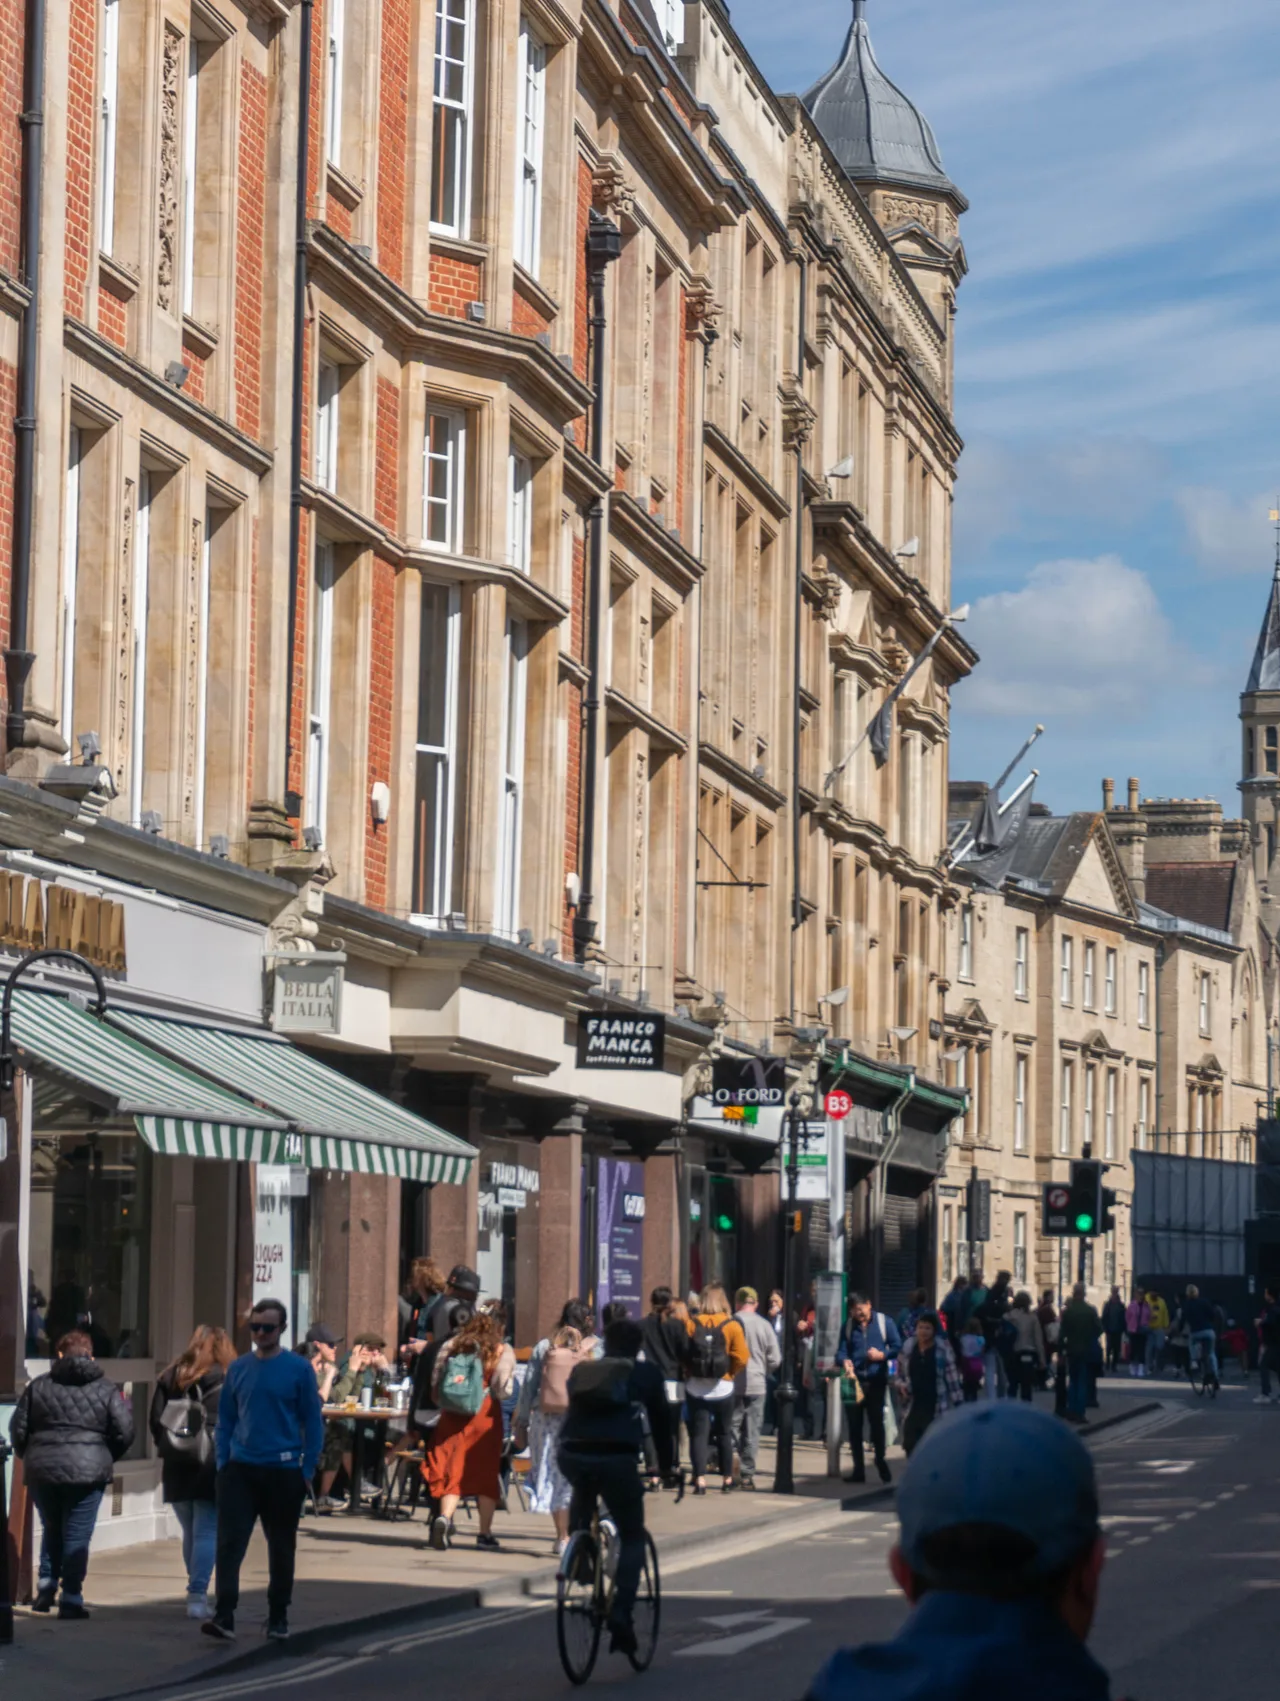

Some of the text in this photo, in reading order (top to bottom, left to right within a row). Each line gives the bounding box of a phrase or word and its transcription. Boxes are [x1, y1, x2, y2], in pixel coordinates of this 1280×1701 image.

[283, 980, 333, 998] BELLA
[281, 1001, 334, 1018] ITALIA
[586, 1019, 656, 1036] FRANCO
[588, 1035, 653, 1054] MANCA
[828, 1095, 850, 1112] B3
